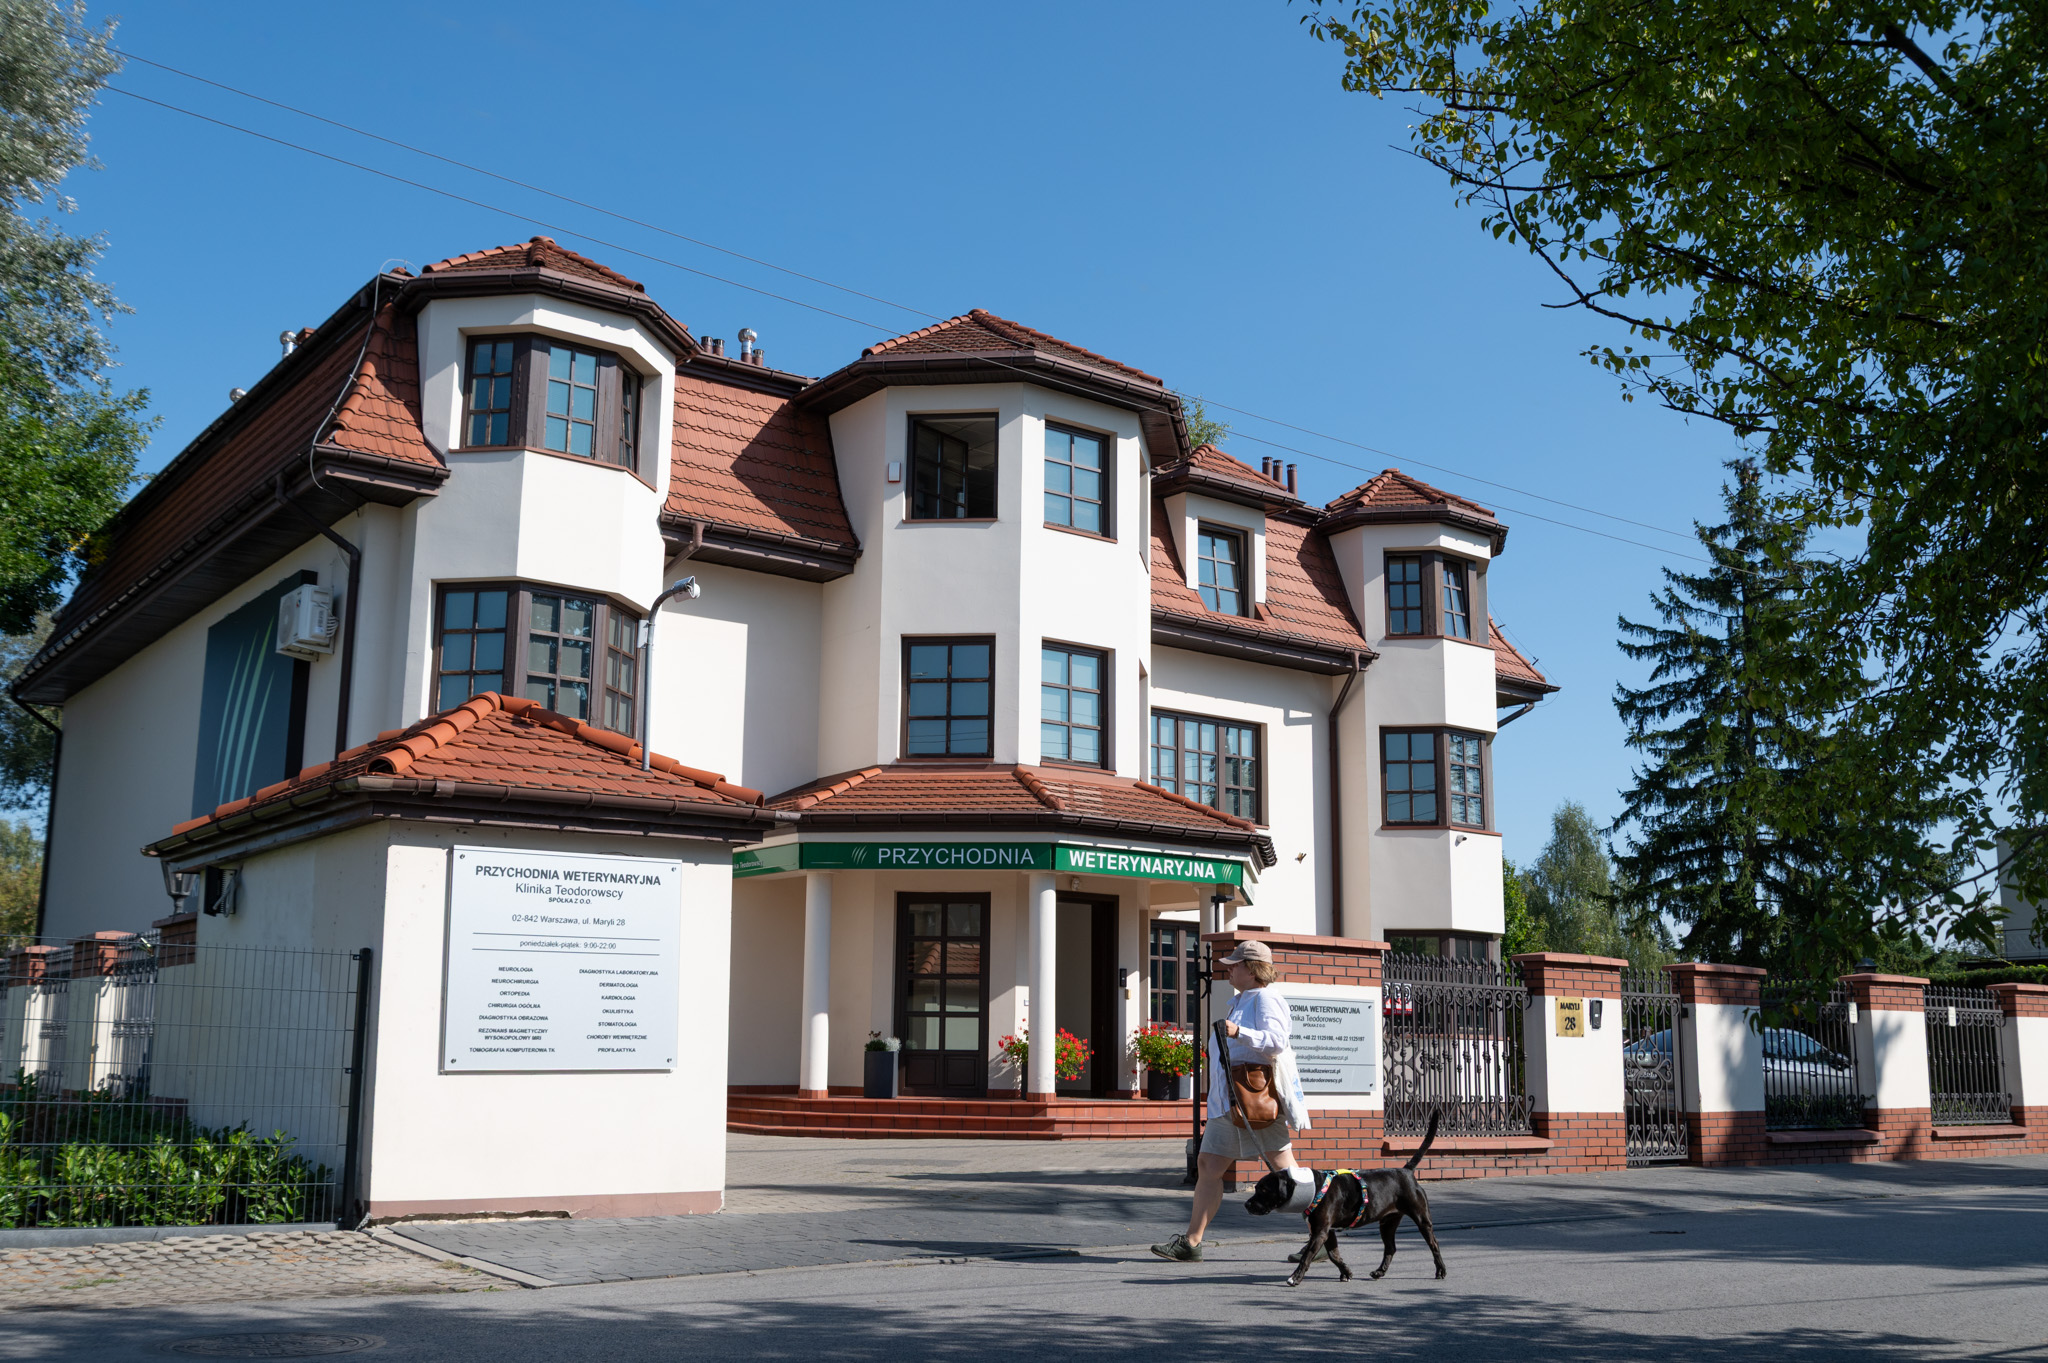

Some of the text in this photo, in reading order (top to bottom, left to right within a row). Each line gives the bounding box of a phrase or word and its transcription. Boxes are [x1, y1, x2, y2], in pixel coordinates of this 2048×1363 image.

[877, 847, 1216, 879] PRZYCHODNIA WETERYNARYJNA
[475, 865, 661, 886] PRZYCHODNIA WETERYNARYJNA
[515, 882, 624, 900] Klinika Teodorowscy
[548, 896, 573, 904] SPÓŁKA
[511, 914, 626, 928] 02-842 Warszawa, ul. Maryli 28
[519, 940, 616, 950] poniedziałek-piątek: 9:00-22:00
[1288, 1004, 1361, 1014] ODNIA WETERYNARYJNA
[1560, 1002, 1580, 1010] MARYLI
[1290, 1013, 1343, 1024] inika Teodorowscy
[1564, 1016, 1576, 1030] 28
[1290, 1044, 1359, 1053] kawarszawa@klinikateodorowscy.pl
